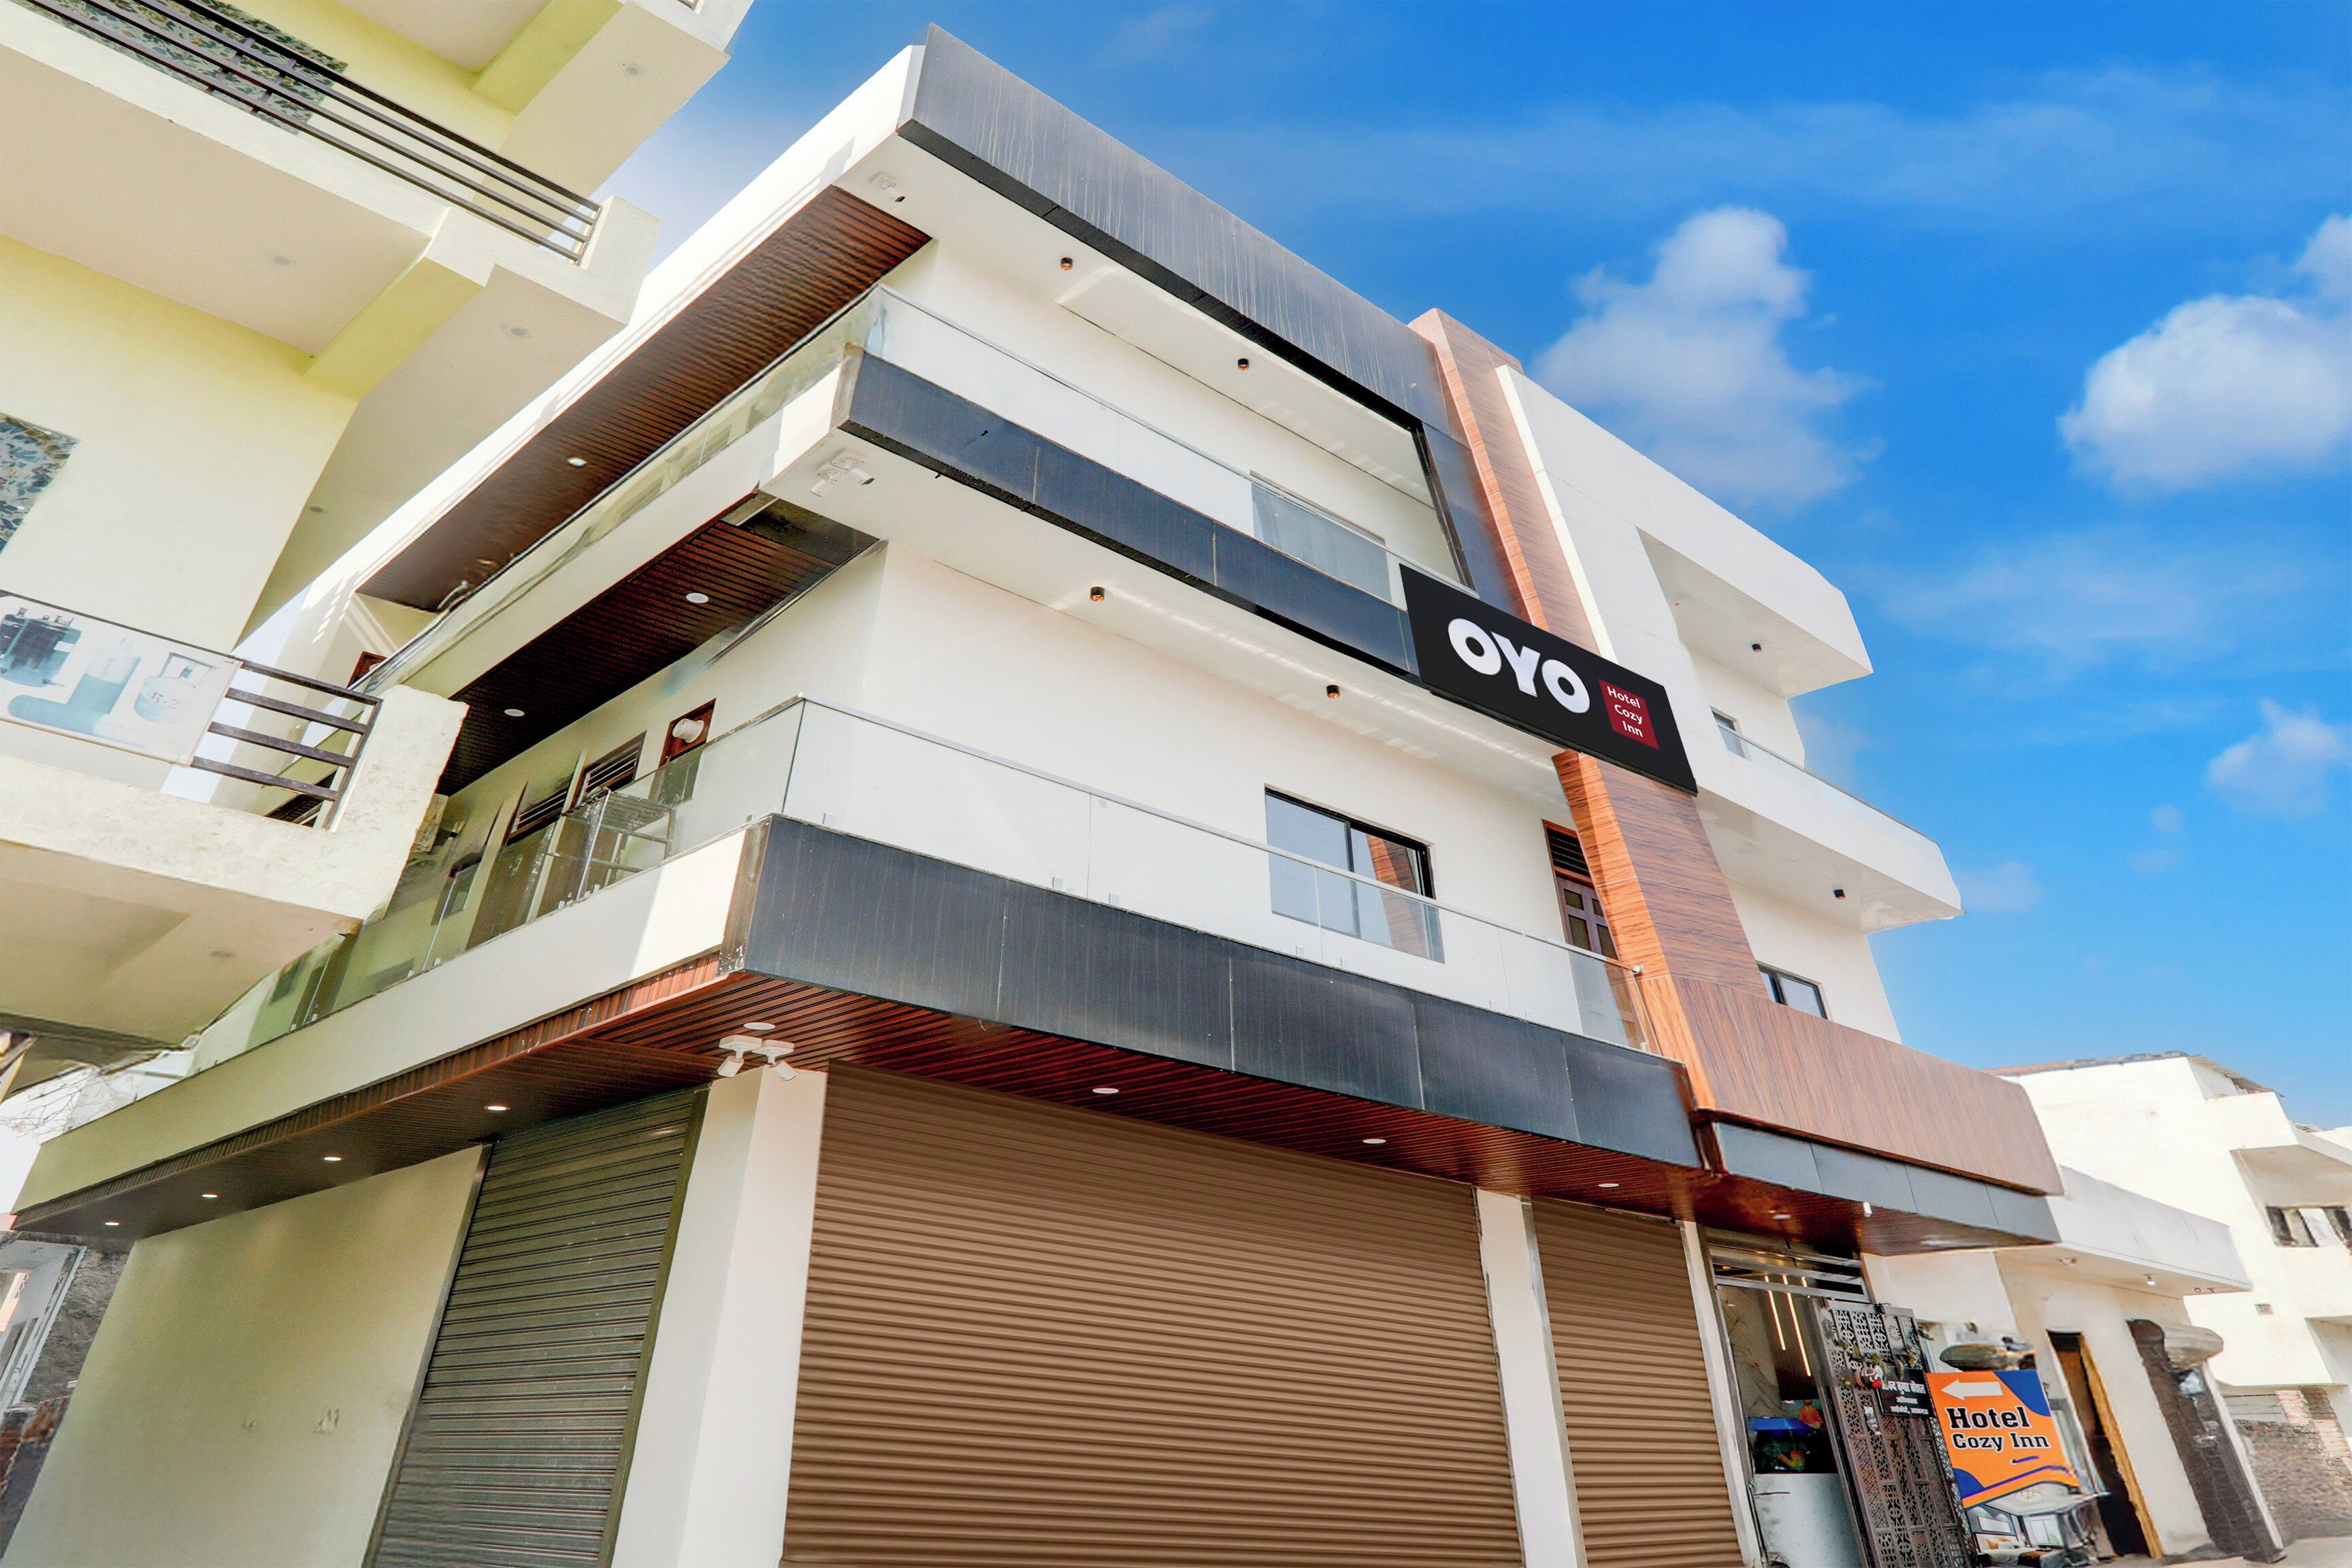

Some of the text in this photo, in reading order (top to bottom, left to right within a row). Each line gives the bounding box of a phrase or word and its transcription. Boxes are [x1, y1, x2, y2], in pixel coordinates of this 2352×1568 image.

[1448, 618, 1590, 714] OYO
[1607, 685, 1641, 709] Hotel
[1614, 704, 1643, 725] Cozy
[1622, 720, 1644, 738] Inn
[1945, 1405, 2031, 1429] Hotel
[1952, 1432, 2050, 1452] Cozy Inn
